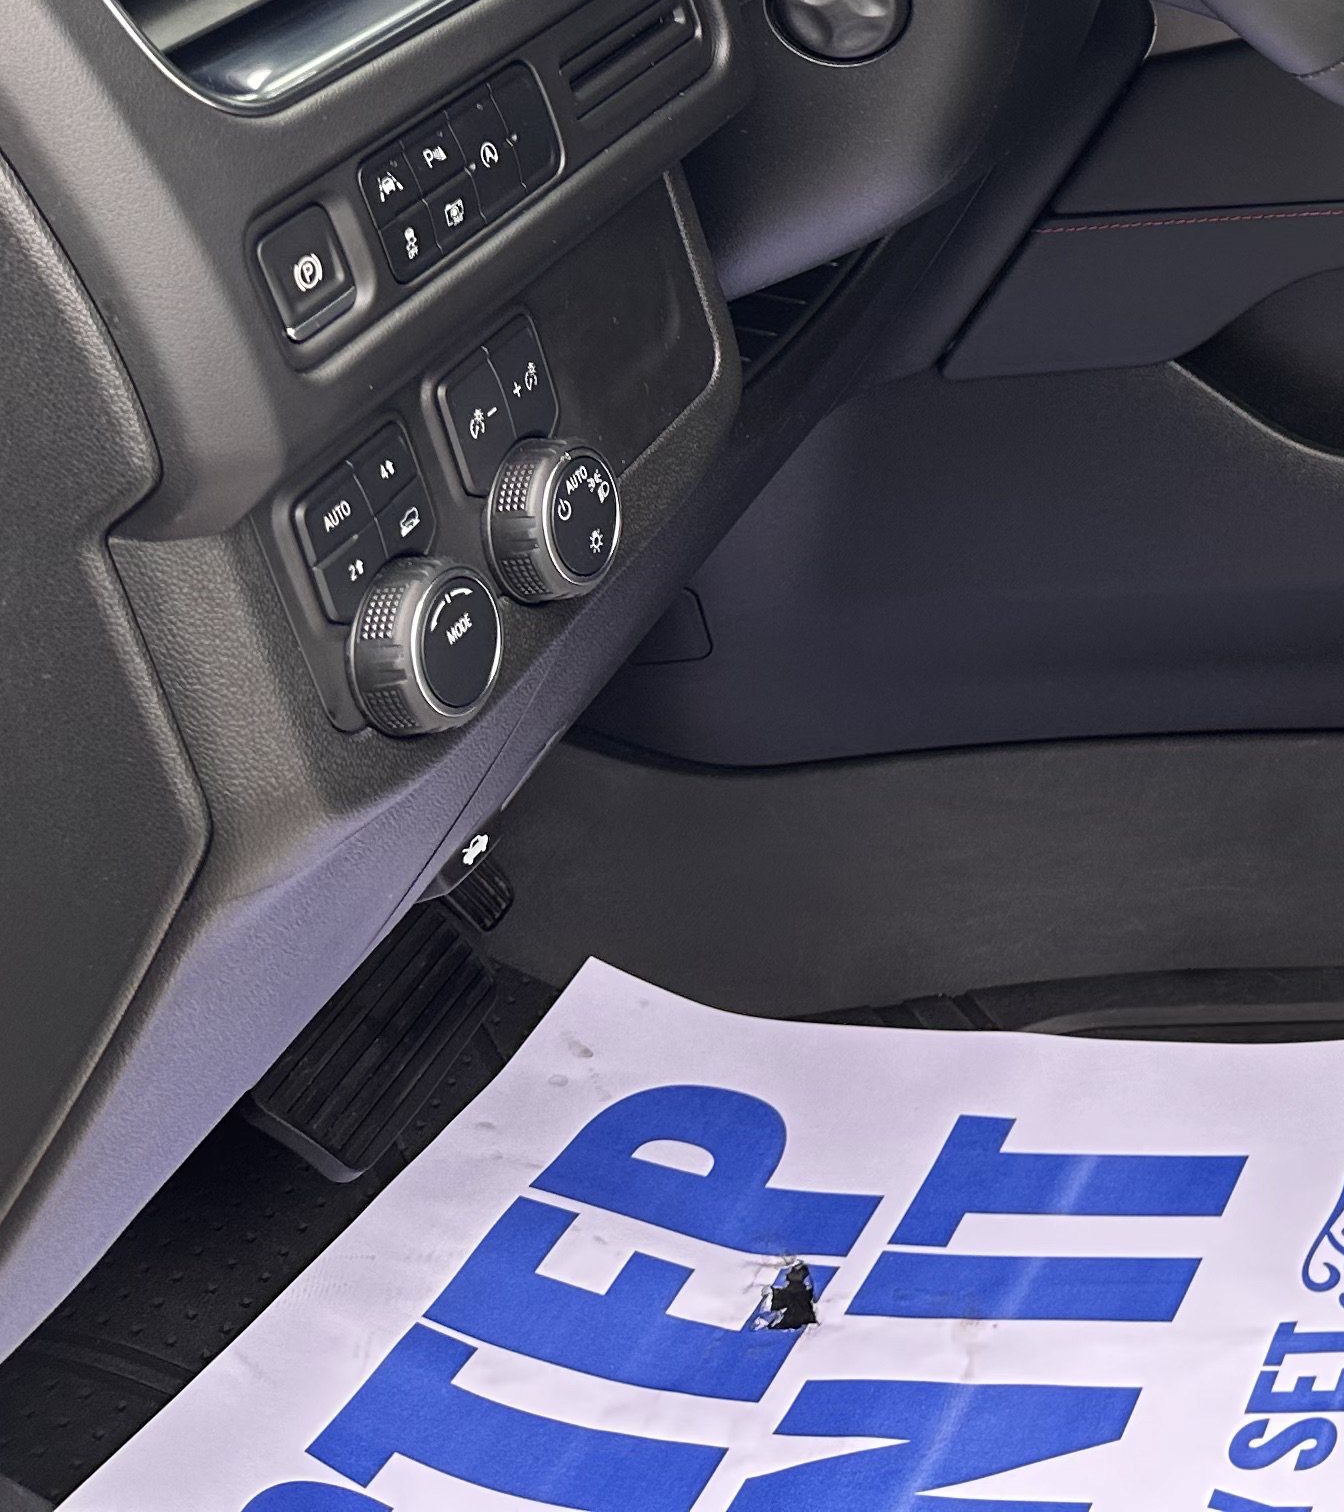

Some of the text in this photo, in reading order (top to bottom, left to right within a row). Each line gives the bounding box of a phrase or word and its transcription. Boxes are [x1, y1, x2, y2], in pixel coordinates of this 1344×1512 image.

[565, 465, 588, 496] AUTO
[323, 500, 351, 532] AUTO
[446, 612, 473, 645] MODE
